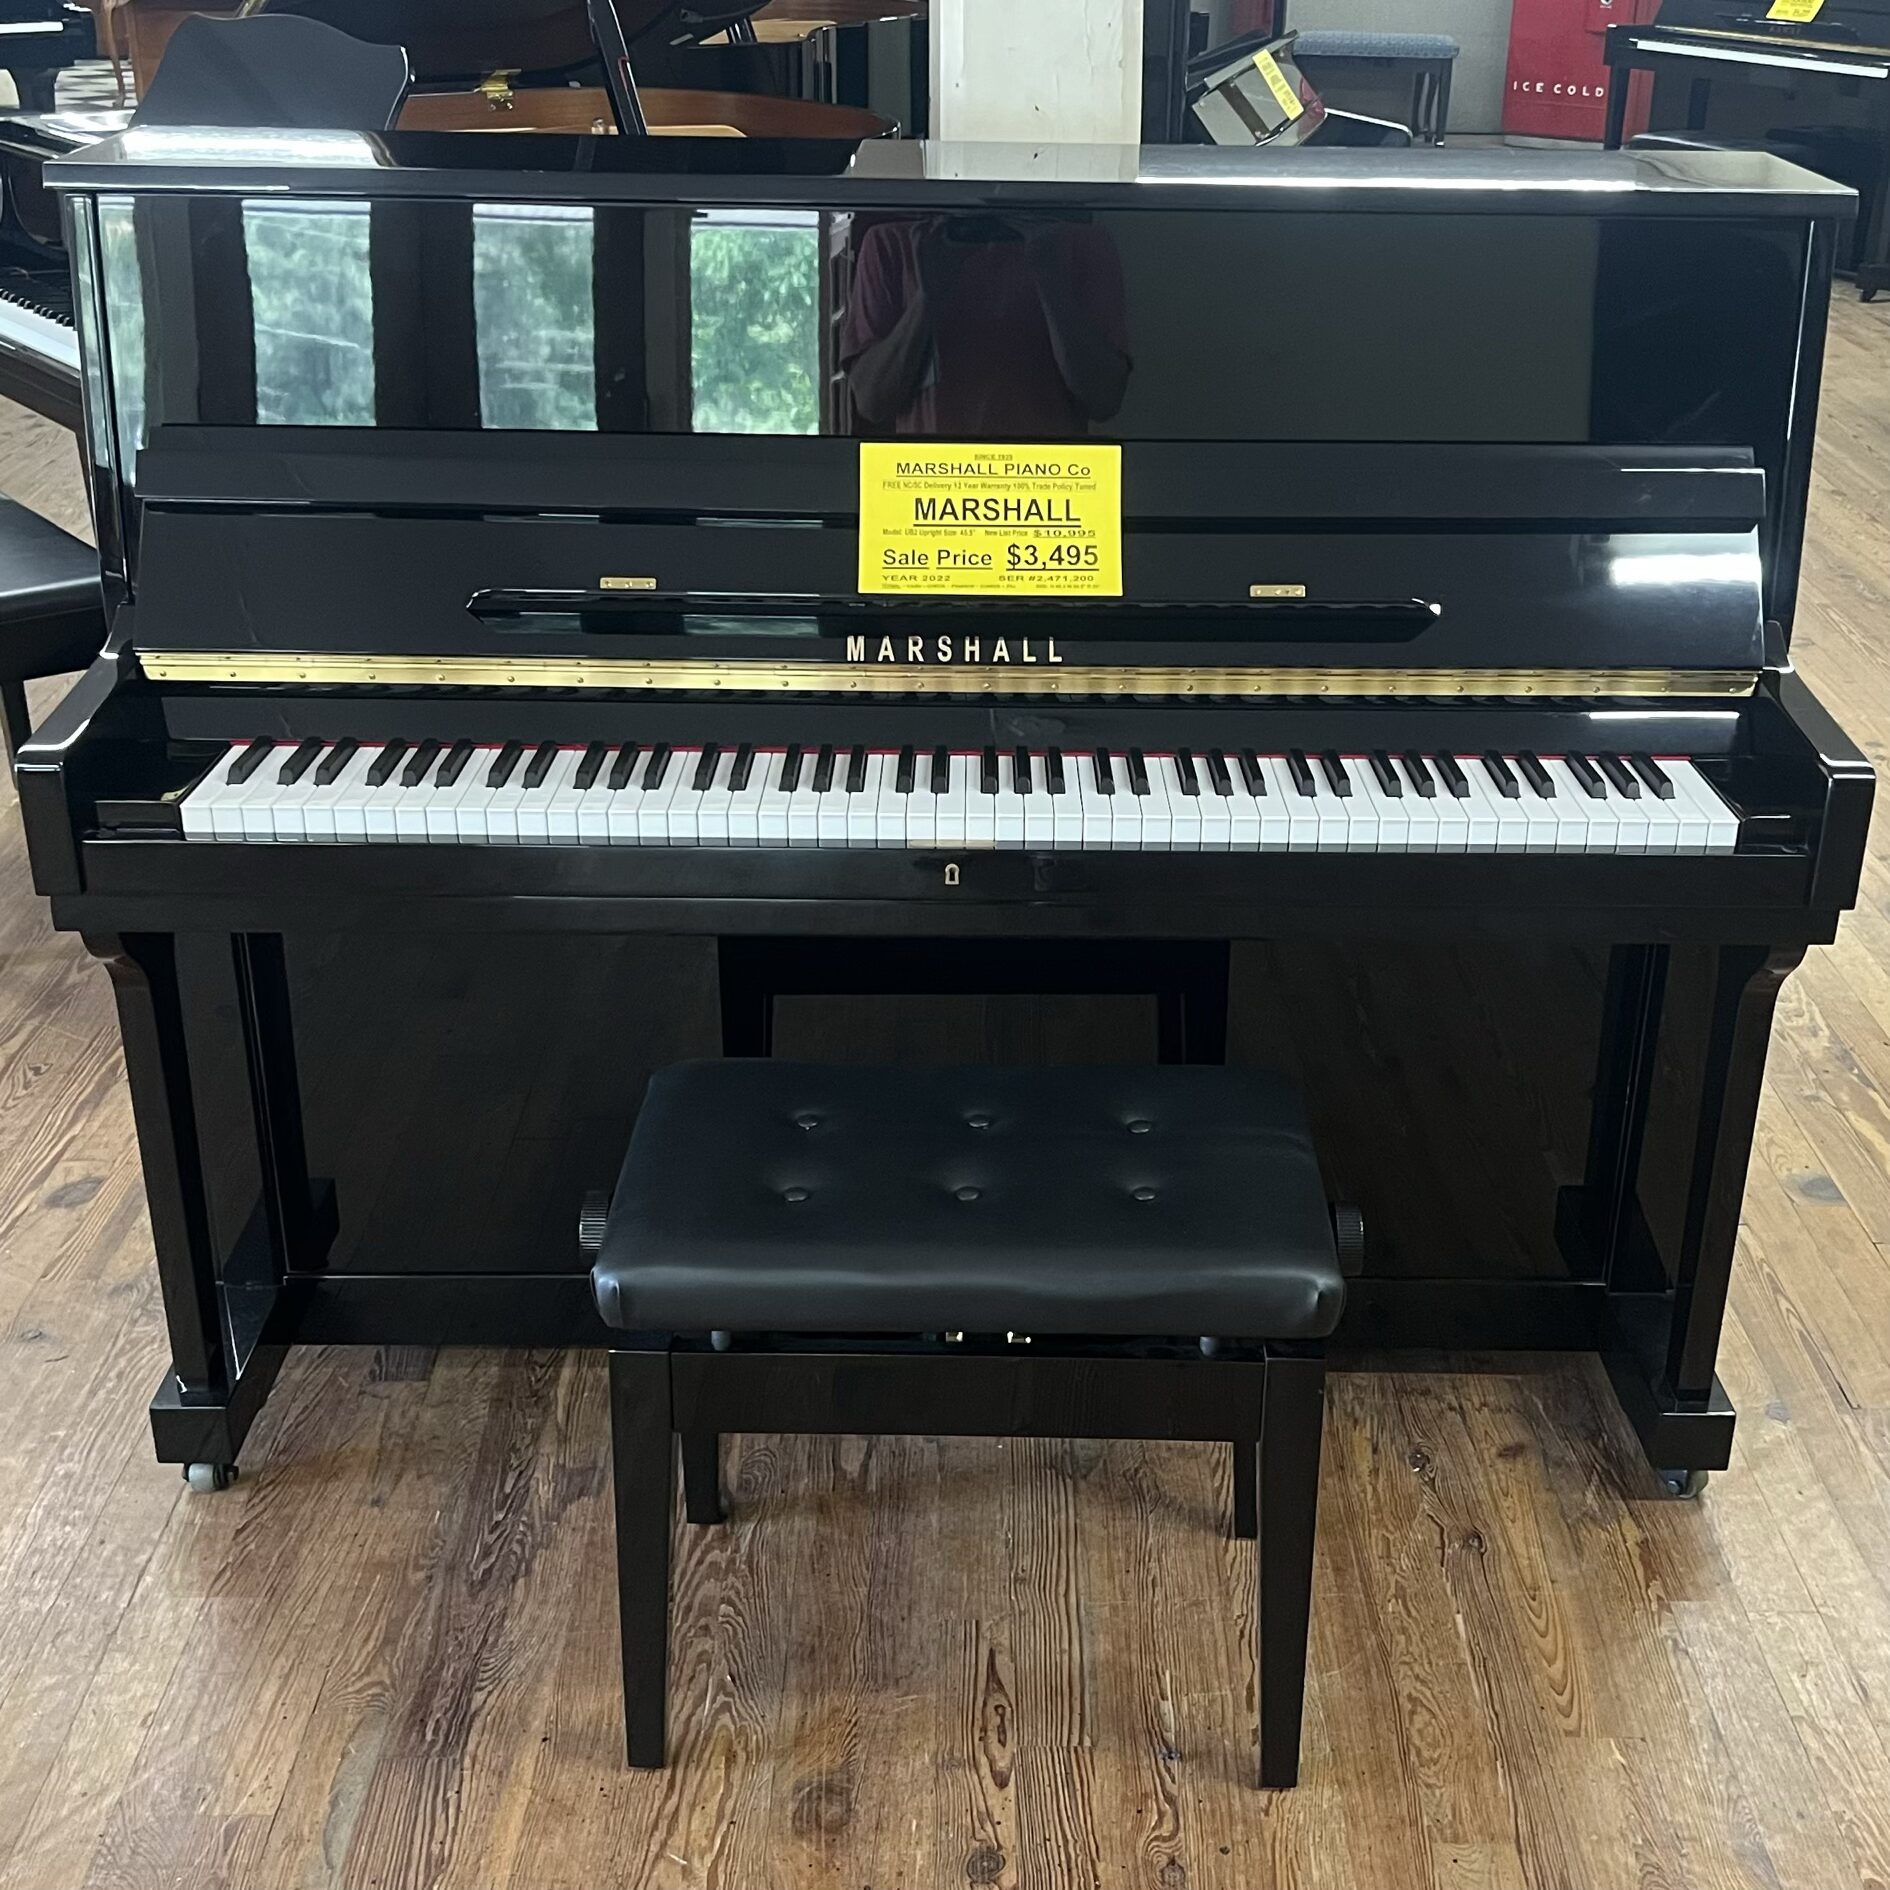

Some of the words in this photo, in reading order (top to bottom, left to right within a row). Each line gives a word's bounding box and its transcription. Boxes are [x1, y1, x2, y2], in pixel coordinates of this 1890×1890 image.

[1513, 80, 1544, 93] ICE
[1553, 83, 1604, 97] COLD
[896, 462, 998, 475] MARSHALL
[1004, 463, 1061, 476] PIANO
[1067, 463, 1091, 476] Co
[882, 481, 901, 489] FREE
[924, 481, 952, 491] Delivery
[980, 482, 1011, 491] Warranty
[1032, 482, 1051, 490] Trade
[1052, 483, 1073, 492] Policy
[914, 497, 1081, 521] MARSHALL
[919, 528, 942, 538] Upright
[1012, 529, 1028, 537] Price
[1033, 529, 1096, 538] $10,995
[882, 548, 929, 565] Sale
[937, 549, 993, 566] Price
[1006, 543, 1099, 570] $3,495
[846, 635, 1063, 662] MARSHALL
